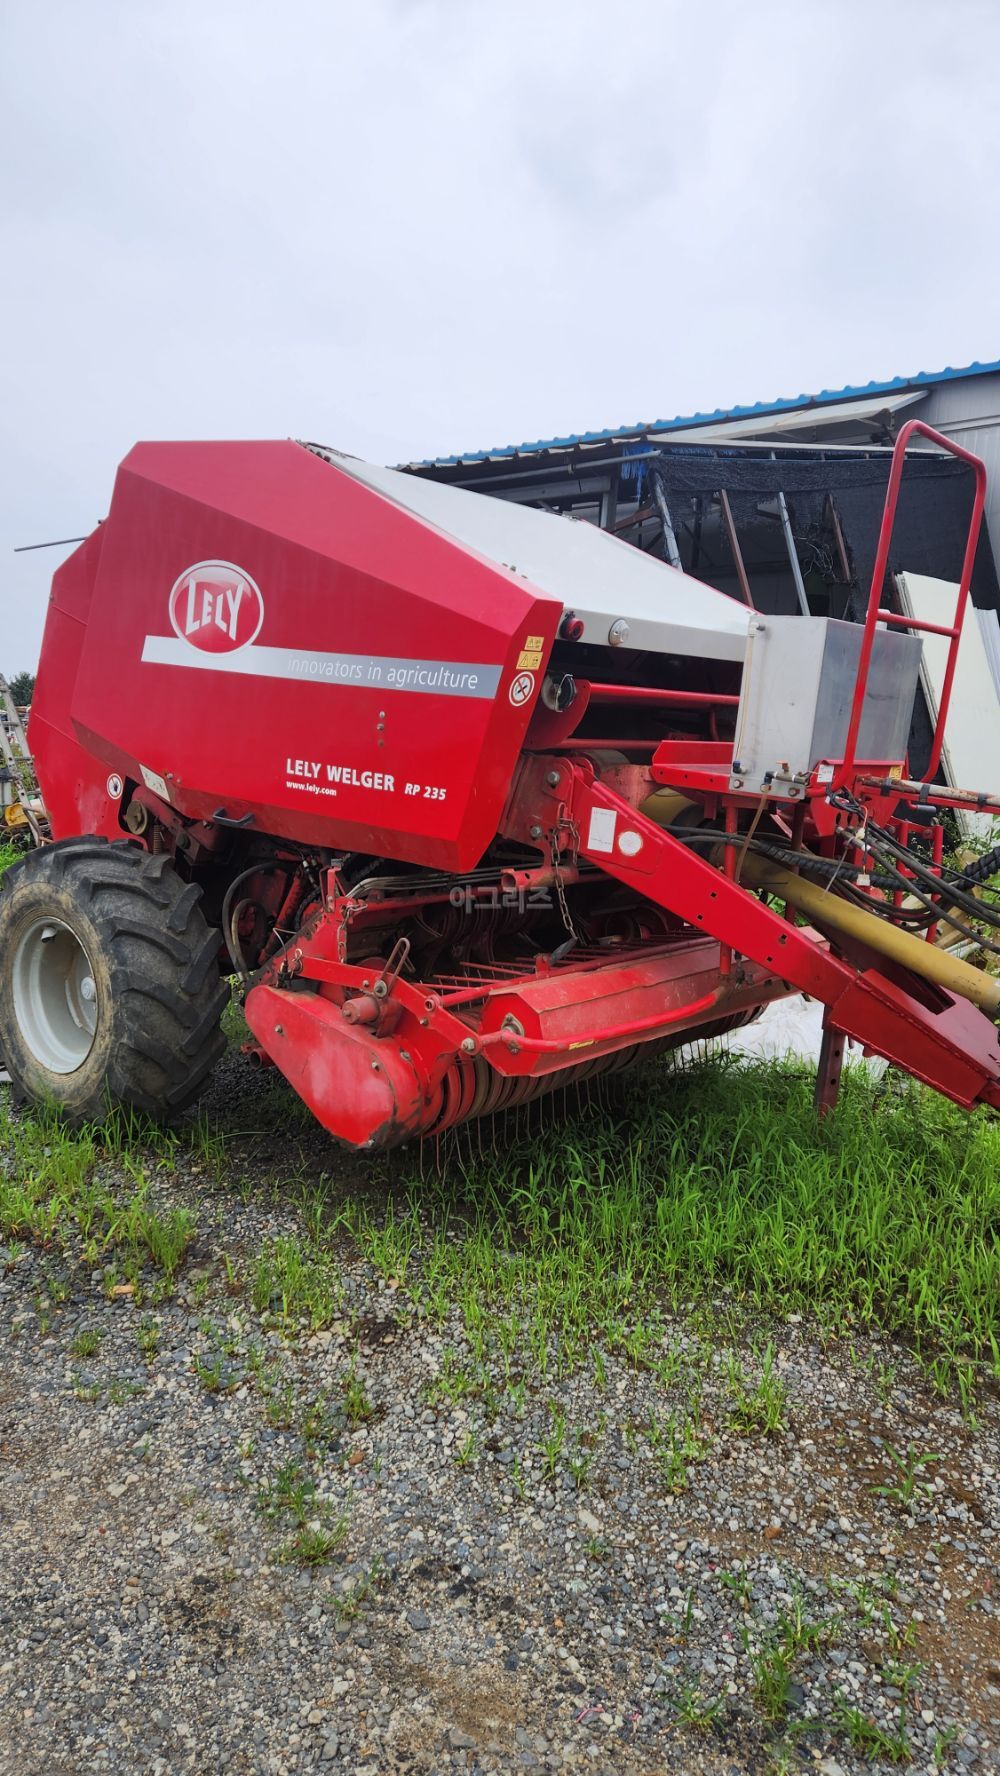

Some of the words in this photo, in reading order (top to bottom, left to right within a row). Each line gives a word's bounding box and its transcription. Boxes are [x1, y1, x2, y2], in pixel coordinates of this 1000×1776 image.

[185, 577, 245, 642] LELY
[287, 658, 363, 679] innovators
[367, 661, 382, 681] in
[387, 665, 478, 689] agriculture
[286, 758, 322, 779] LELY
[327, 765, 395, 792] WELGER
[404, 783, 421, 796] RP
[423, 786, 447, 801] 235
[286, 780, 337, 797] www.lely.com
